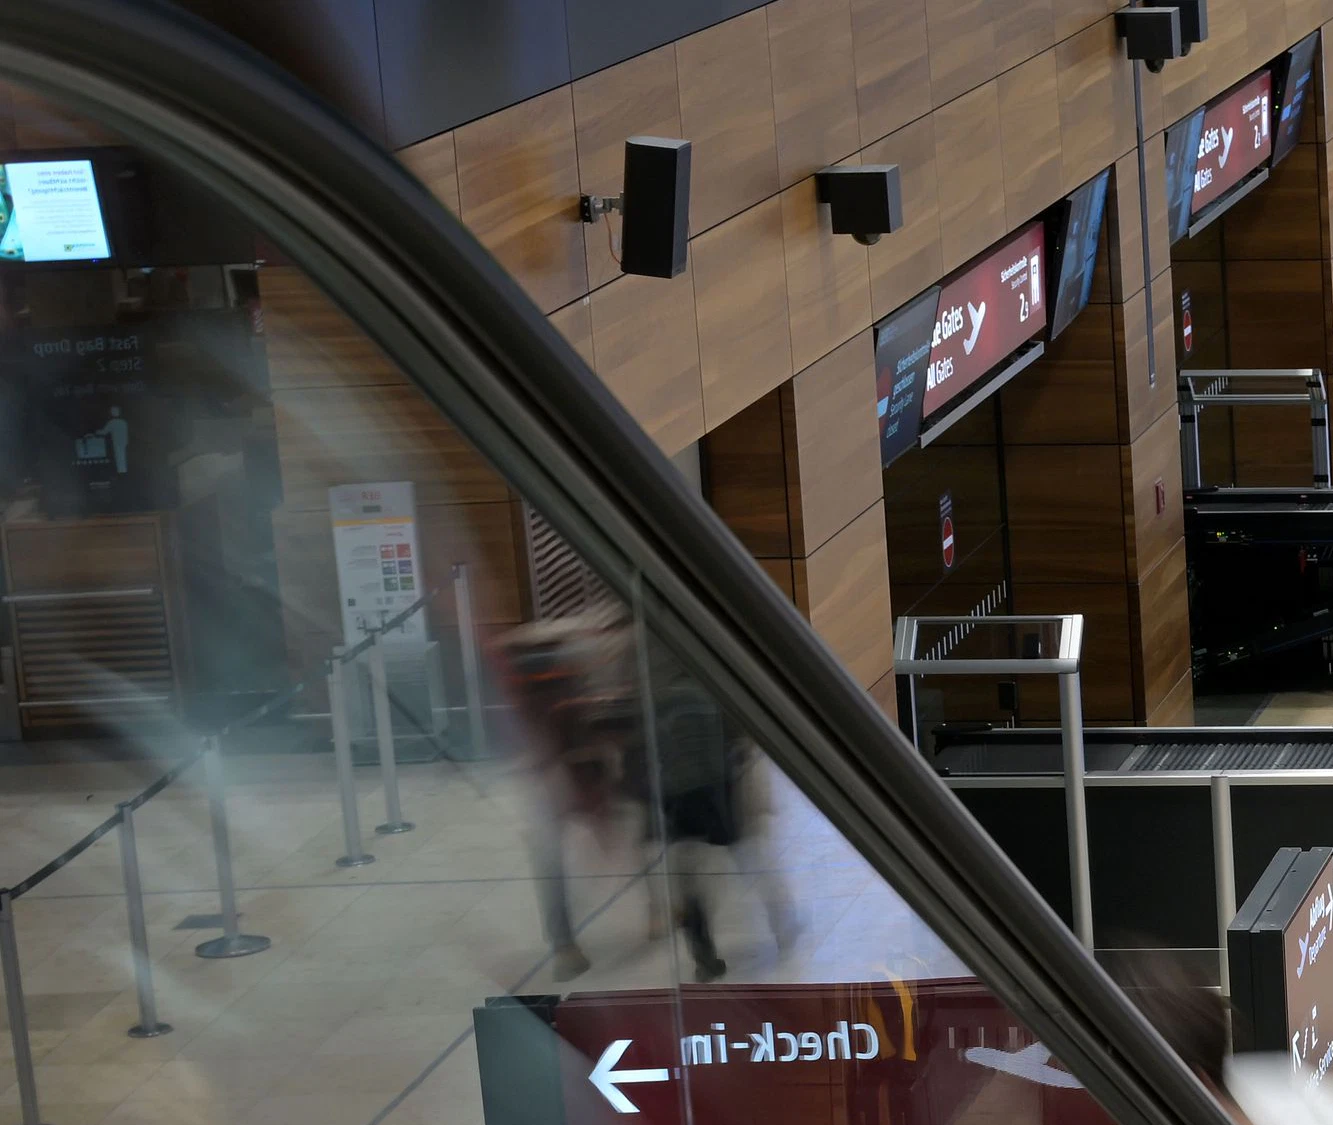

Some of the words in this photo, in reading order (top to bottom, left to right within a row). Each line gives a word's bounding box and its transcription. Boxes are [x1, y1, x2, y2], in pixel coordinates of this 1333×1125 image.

[941, 305, 964, 340] Gates
[926, 362, 936, 392] All
[936, 356, 953, 384] Gates
